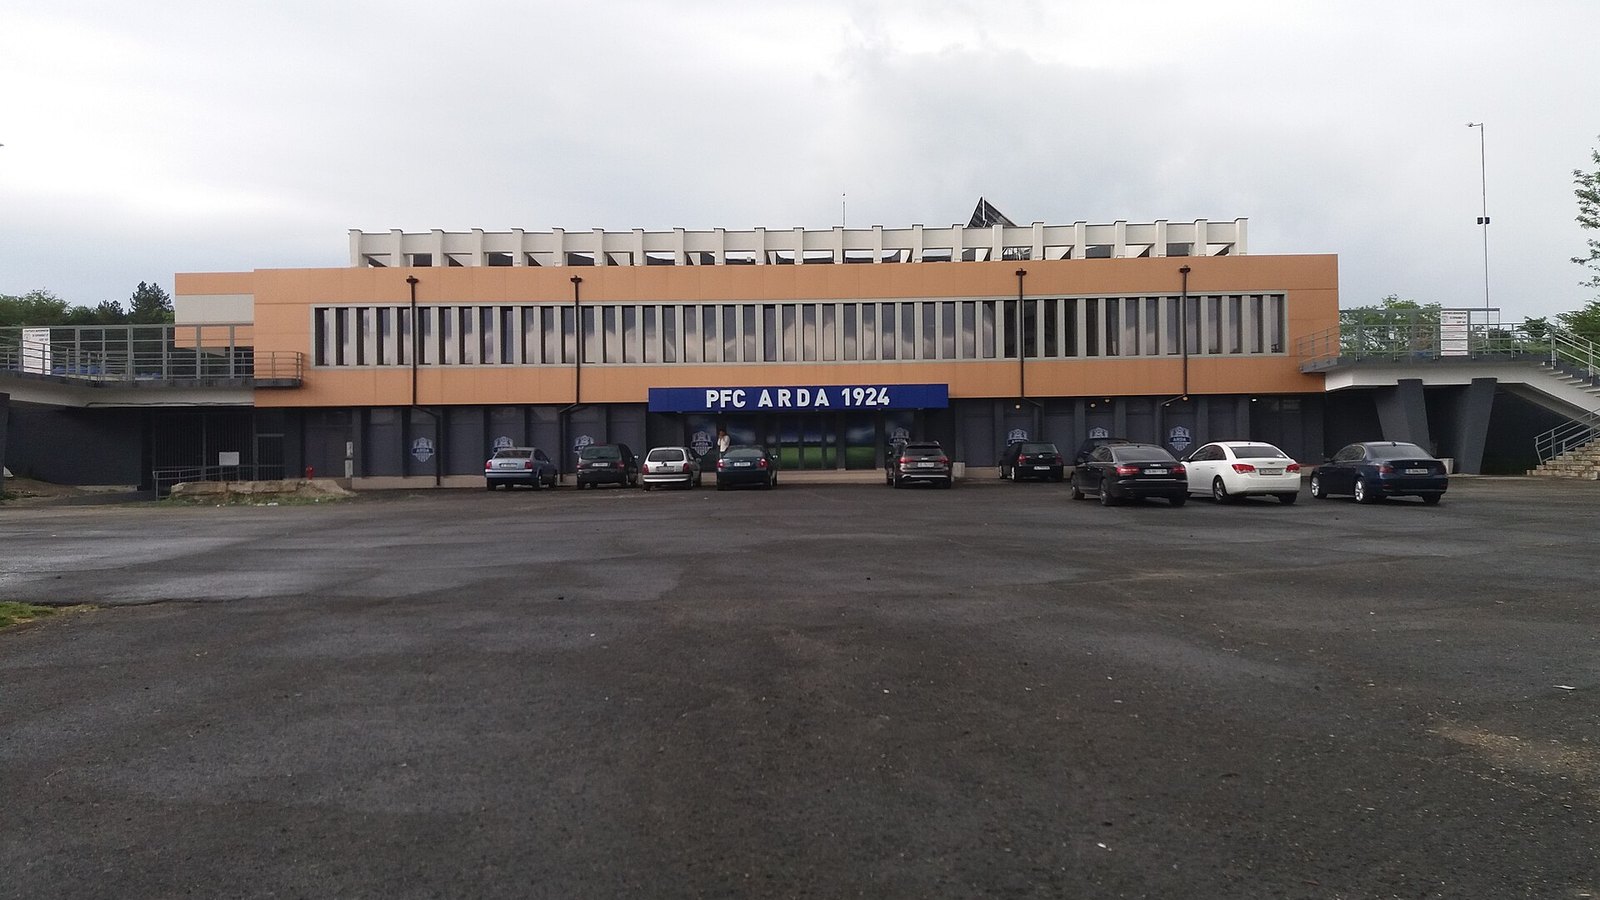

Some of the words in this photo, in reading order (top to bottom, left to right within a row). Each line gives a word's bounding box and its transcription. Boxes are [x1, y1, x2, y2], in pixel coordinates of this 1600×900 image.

[706, 389, 746, 408] PFC
[757, 388, 830, 408] ARDA
[841, 387, 890, 406] 1924
